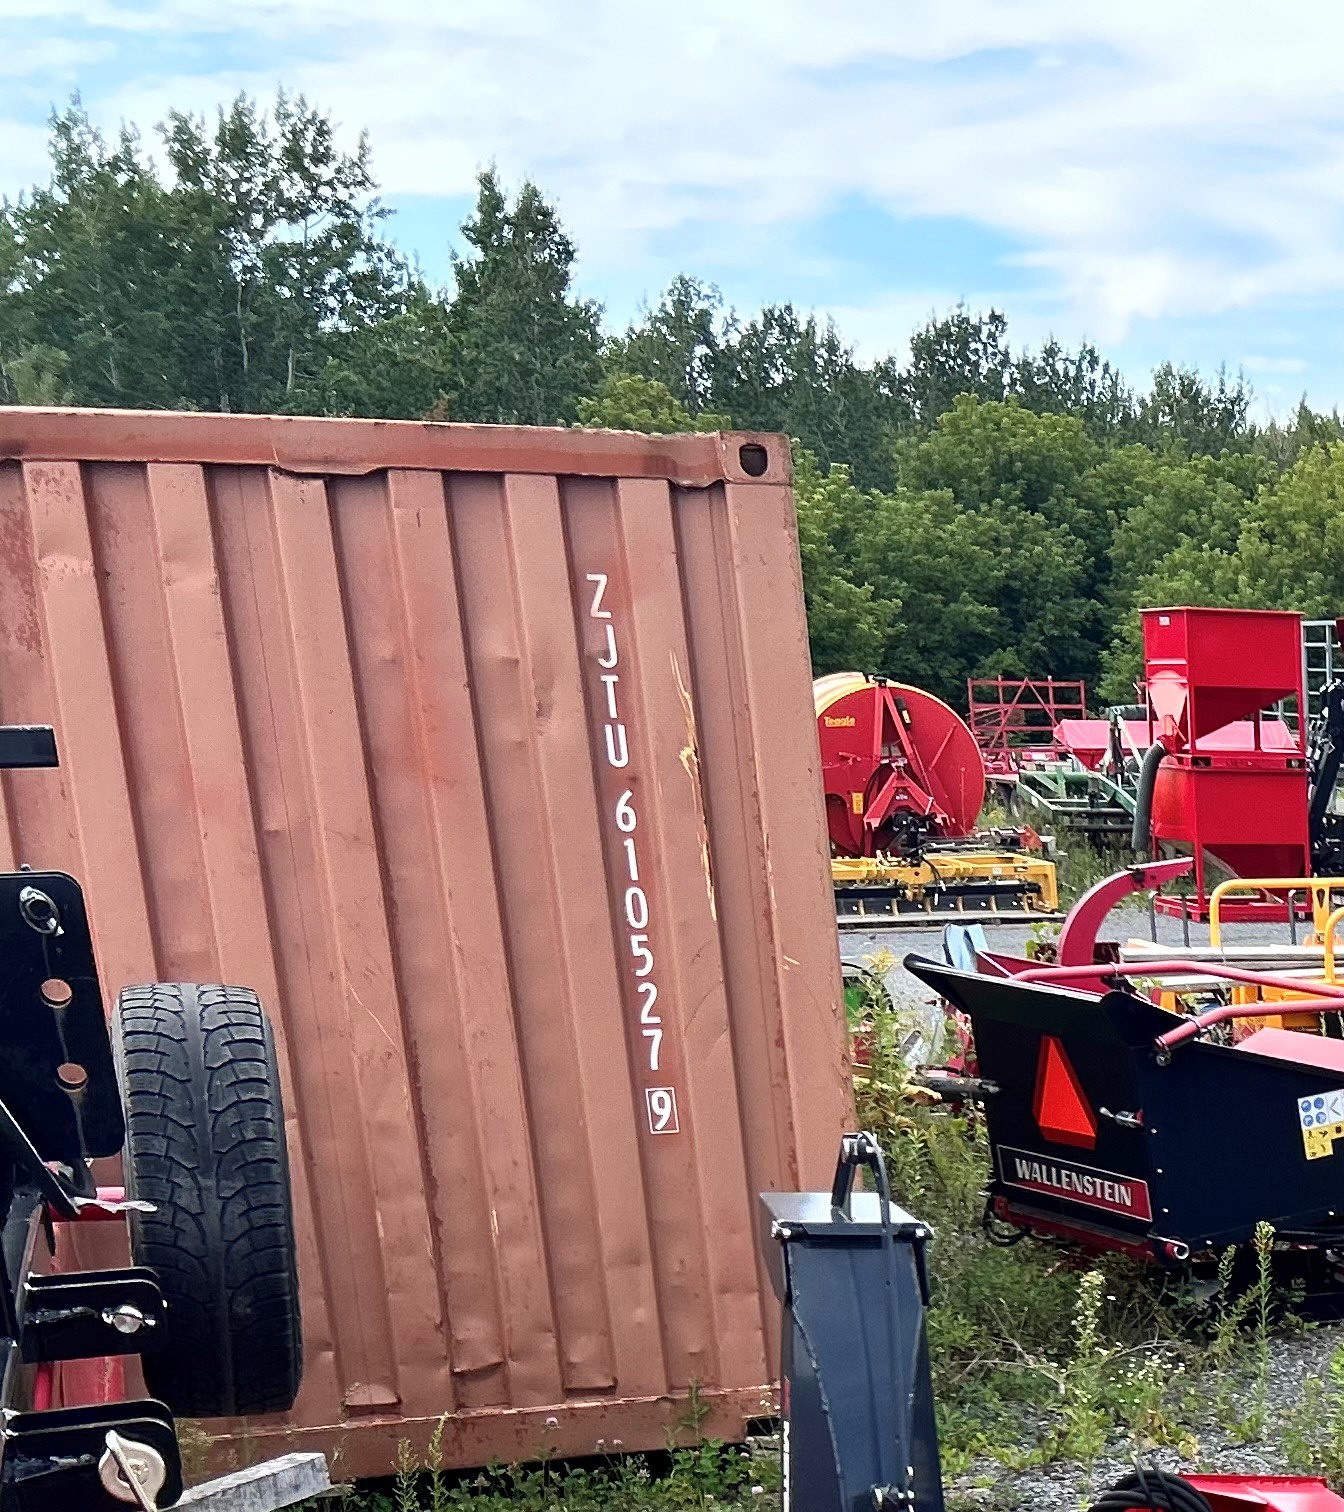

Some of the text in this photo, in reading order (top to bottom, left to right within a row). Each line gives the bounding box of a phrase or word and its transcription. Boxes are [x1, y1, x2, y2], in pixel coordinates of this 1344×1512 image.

[824, 716, 856, 727] Teagle
[586, 573, 629, 769] ZJTU
[614, 790, 664, 1073] 610527
[1015, 1157, 1132, 1207] WALLENSTEIN
